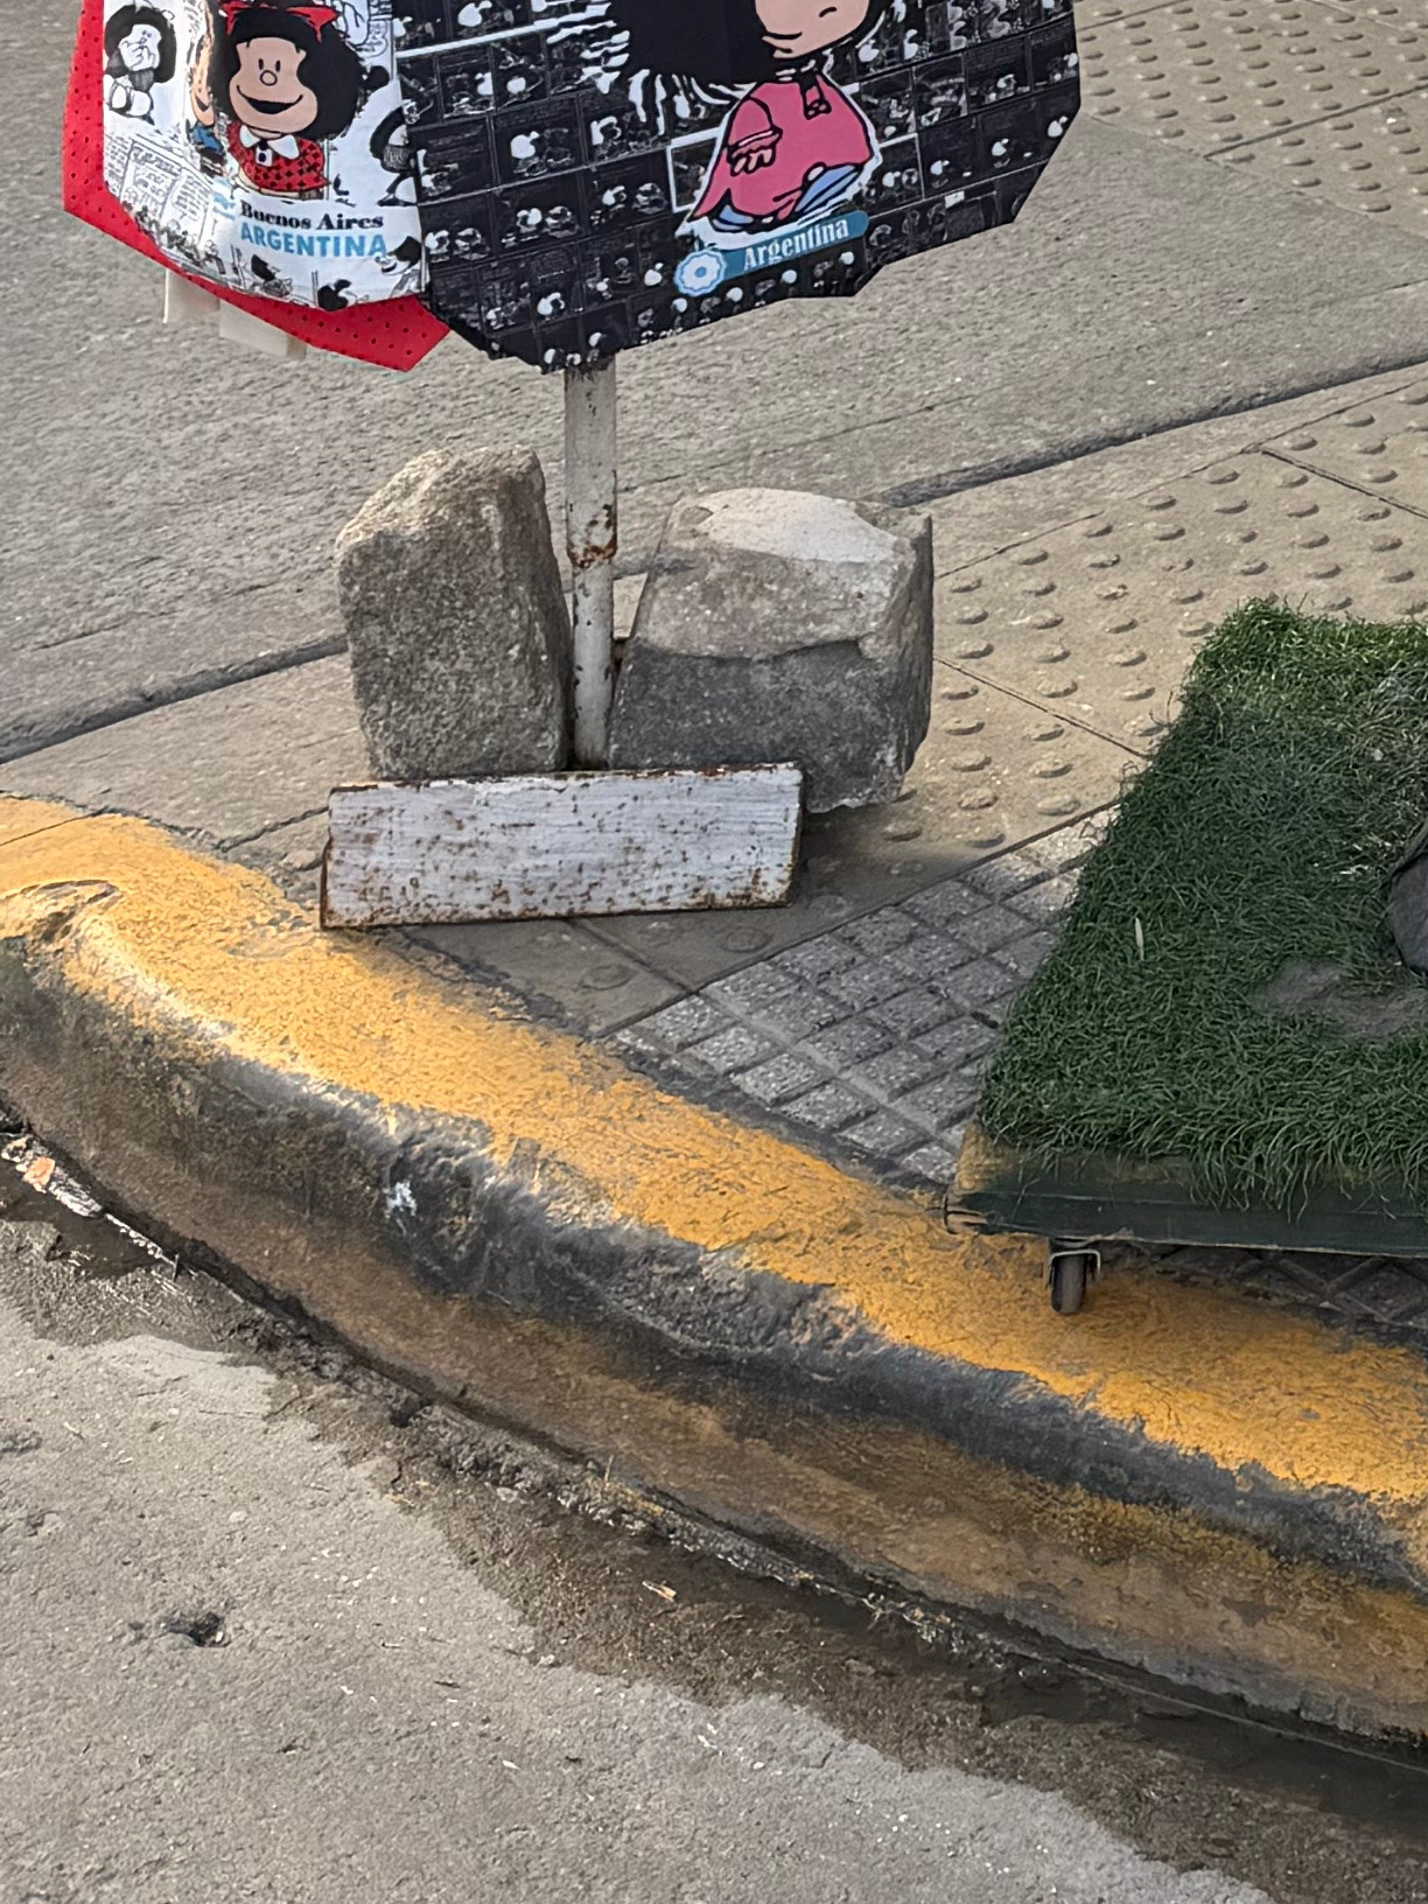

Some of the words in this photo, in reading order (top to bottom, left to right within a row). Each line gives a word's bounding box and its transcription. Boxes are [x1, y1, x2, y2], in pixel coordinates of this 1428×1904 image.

[239, 200, 312, 230] Buenos
[316, 213, 385, 231] Aires
[240, 221, 388, 259] ARGENTINA
[743, 217, 850, 272] Argentina
